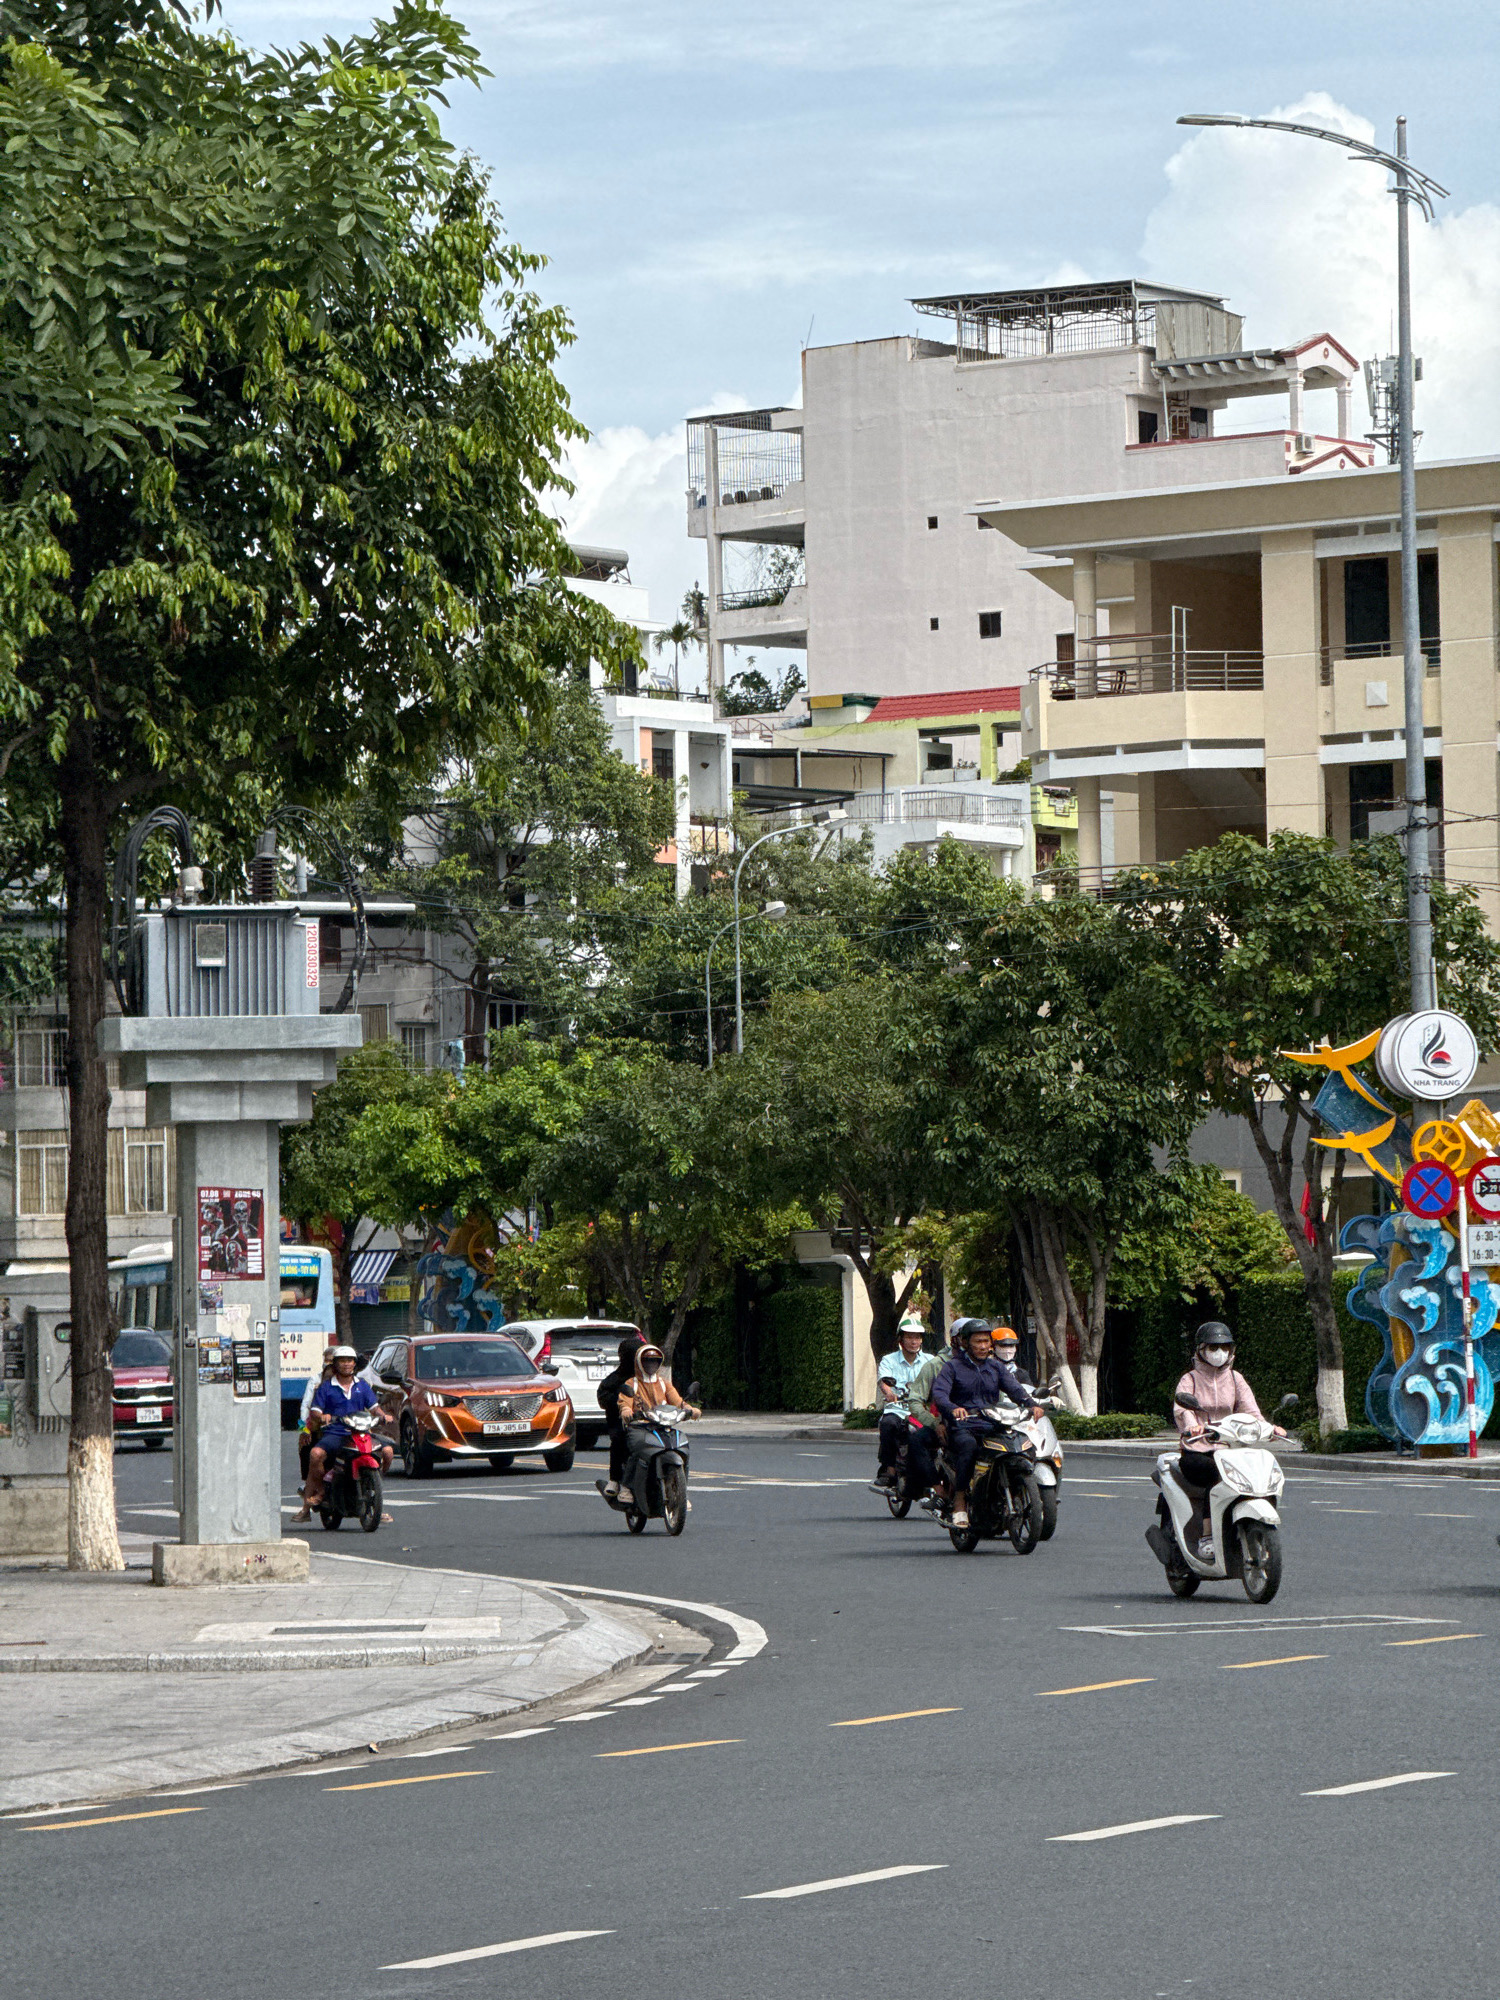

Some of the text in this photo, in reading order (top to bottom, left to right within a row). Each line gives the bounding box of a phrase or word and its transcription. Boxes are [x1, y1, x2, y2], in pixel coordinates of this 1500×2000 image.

[307, 924, 318, 987] 1203030329
[1475, 1231, 1500, 1241] 6:30-
[1472, 1249, 1500, 1260] 16:30-
